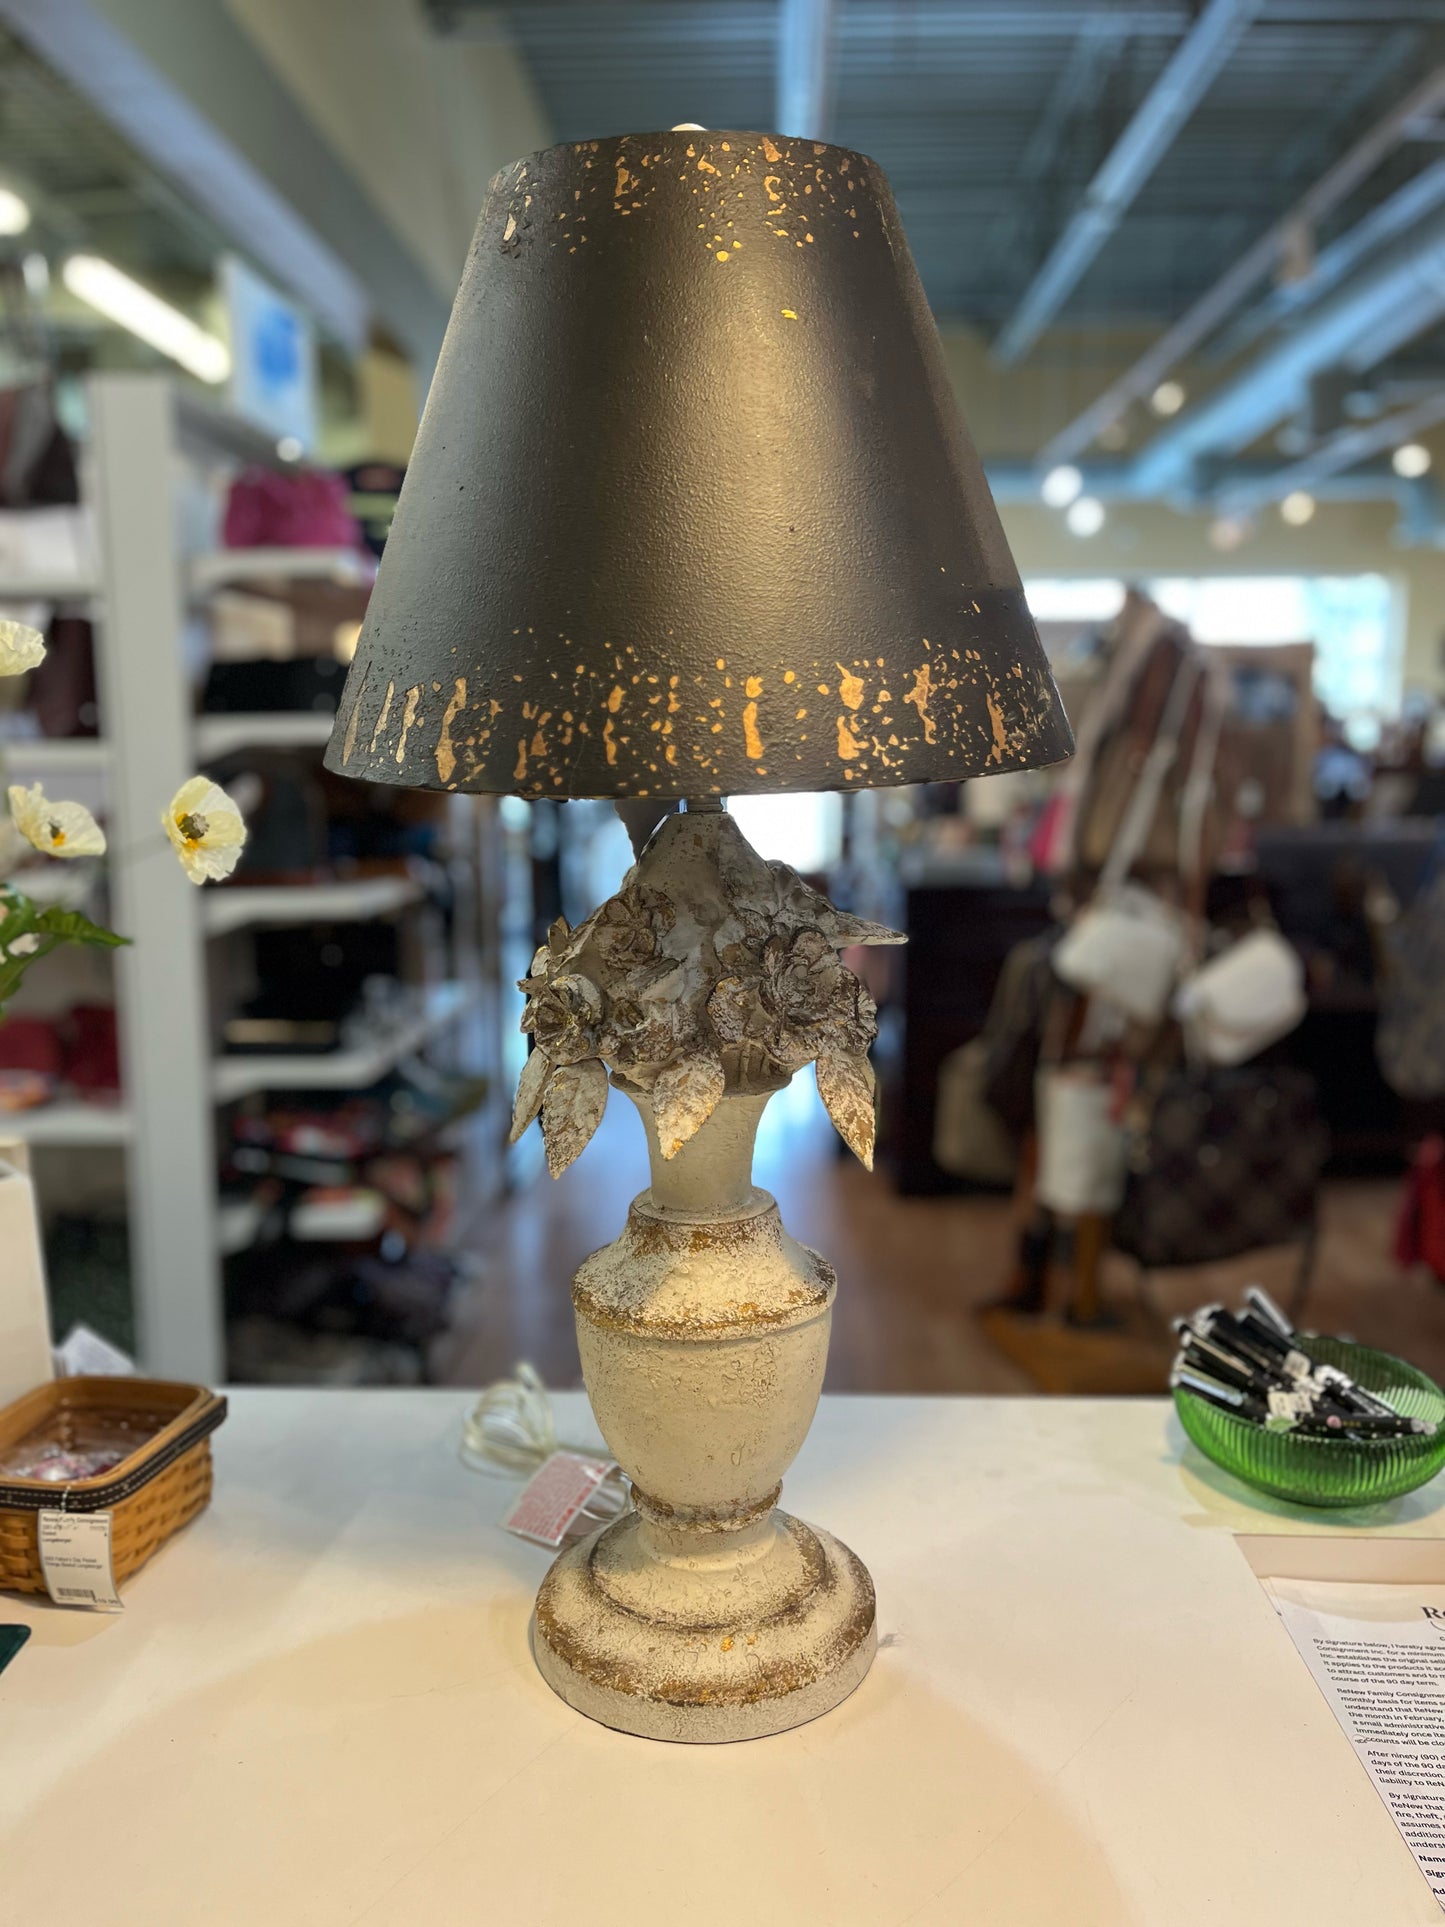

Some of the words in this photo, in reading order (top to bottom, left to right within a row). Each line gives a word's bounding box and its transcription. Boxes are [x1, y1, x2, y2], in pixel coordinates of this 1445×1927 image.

[1340, 1696, 1376, 1704] monthly
[1344, 1704, 1394, 1712] understand
[1404, 1714, 1444, 1722] February,
[1356, 1728, 1408, 1738] immediately
[1379, 1777, 1412, 1786] liability
[1415, 1812, 1442, 1820] theft,
